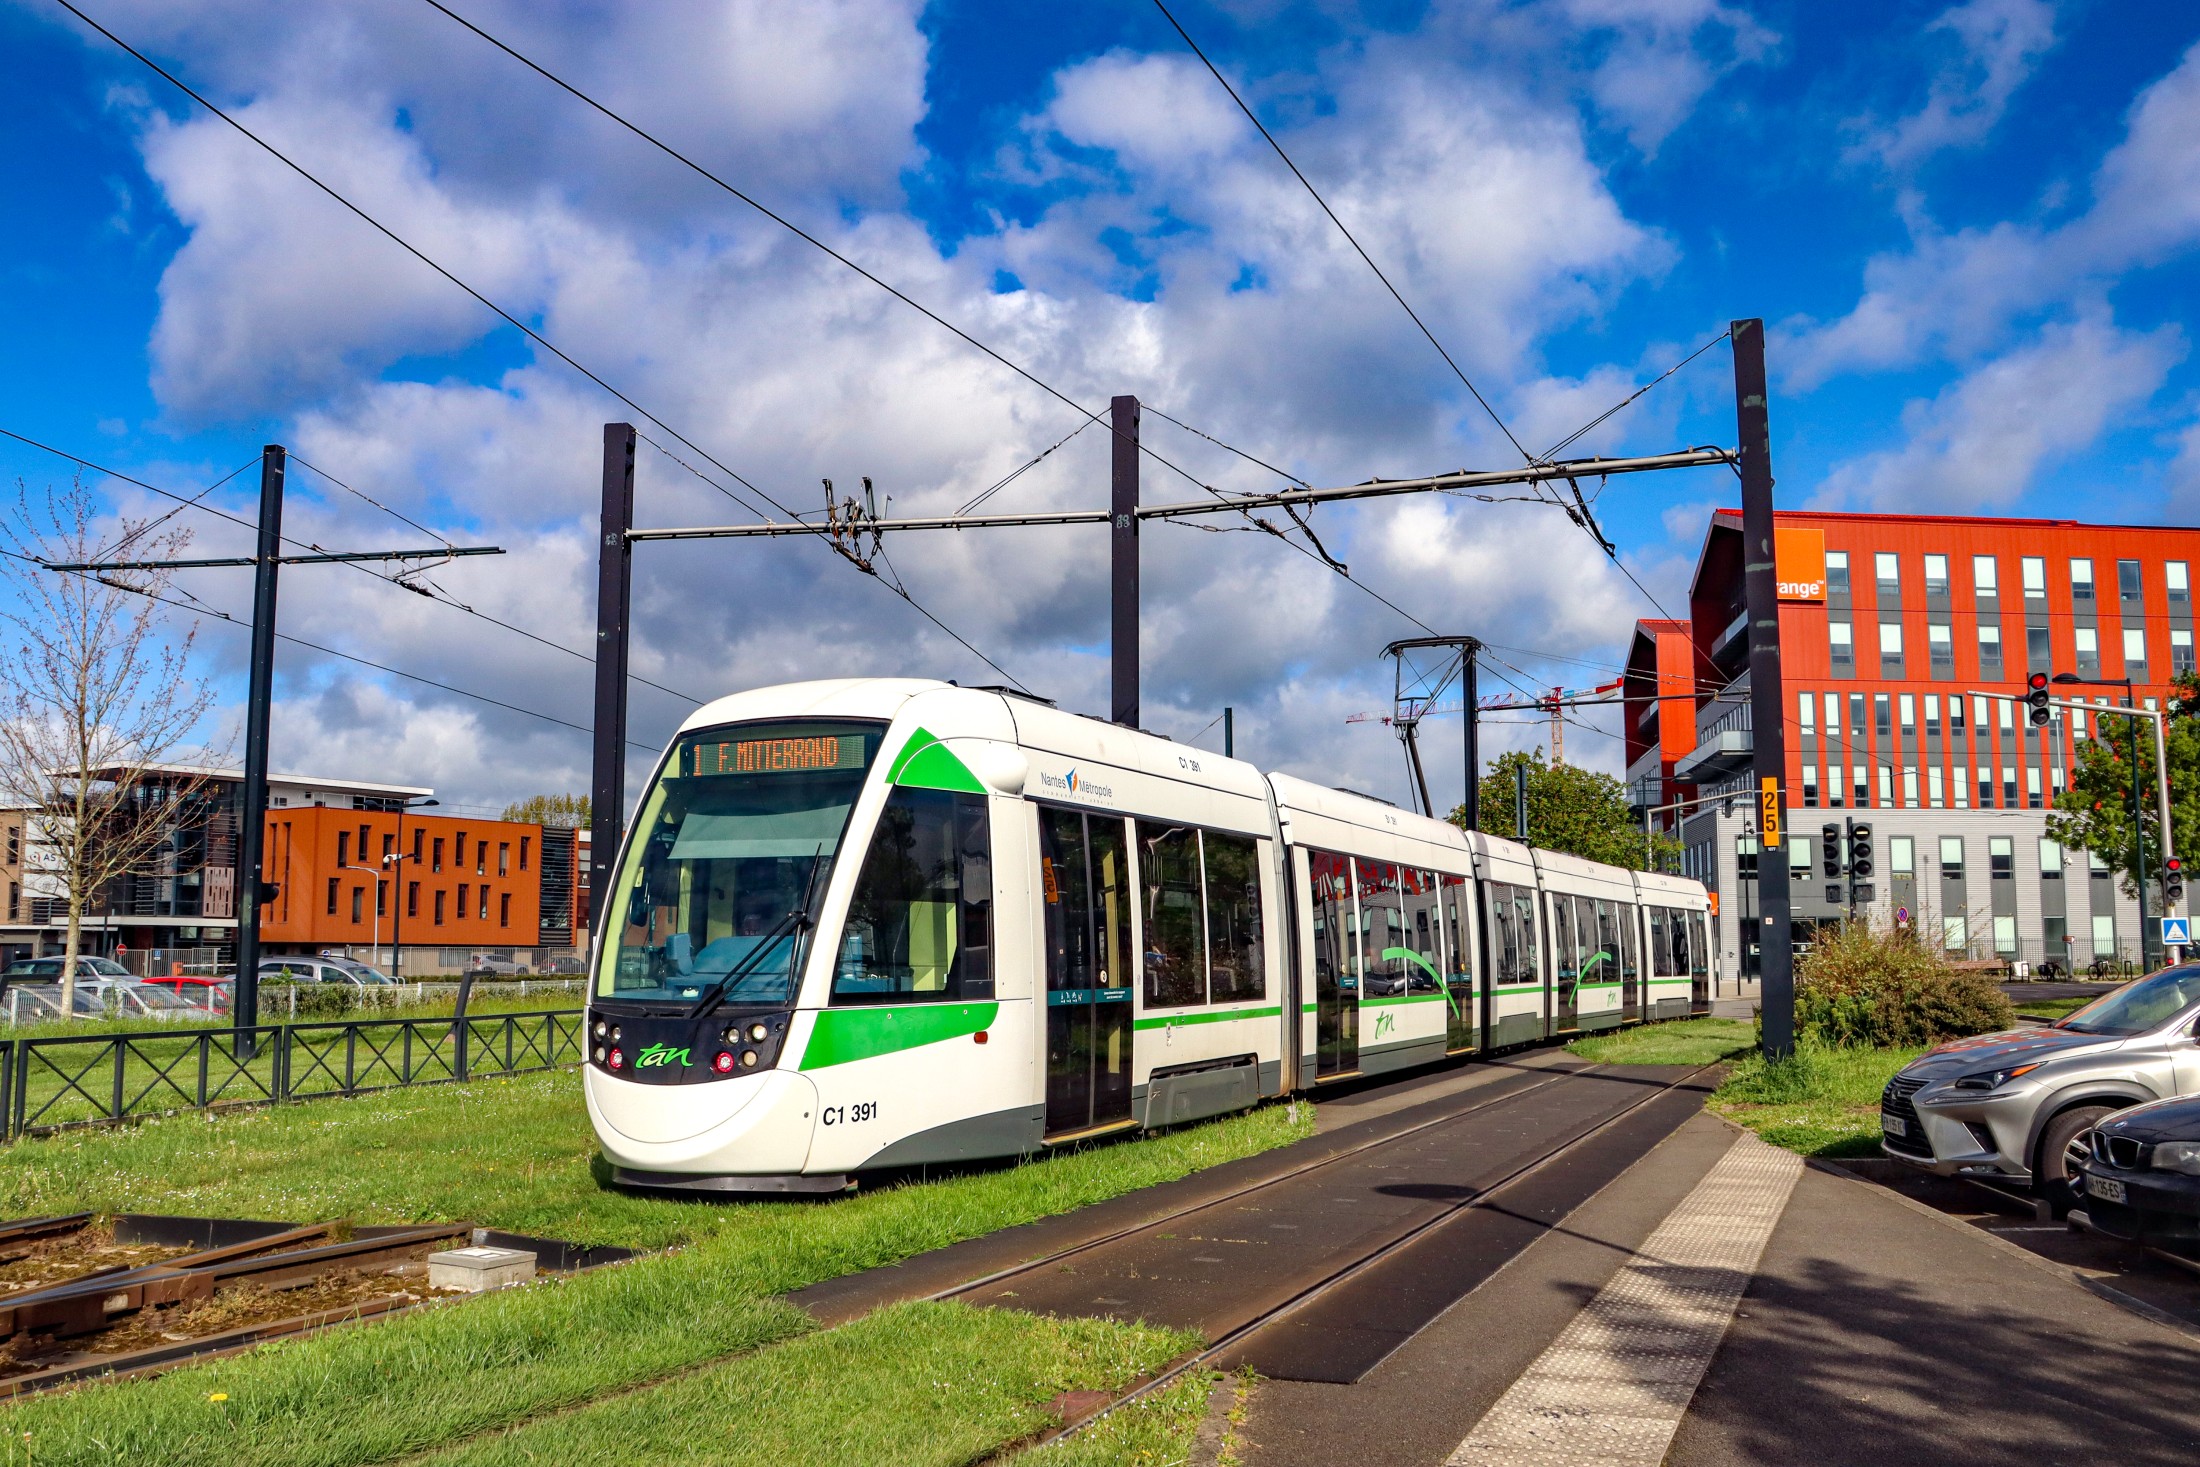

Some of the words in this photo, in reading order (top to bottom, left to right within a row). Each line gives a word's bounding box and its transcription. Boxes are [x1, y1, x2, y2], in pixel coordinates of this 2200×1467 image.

[1776, 582, 1820, 598] ange
[693, 744, 702, 776] 1
[1041, 771, 1067, 789] Nantes
[1079, 779, 1113, 798] Métropole
[635, 1042, 694, 1069] tan
[823, 1106, 844, 1126] C1
[851, 1100, 877, 1123] 391
